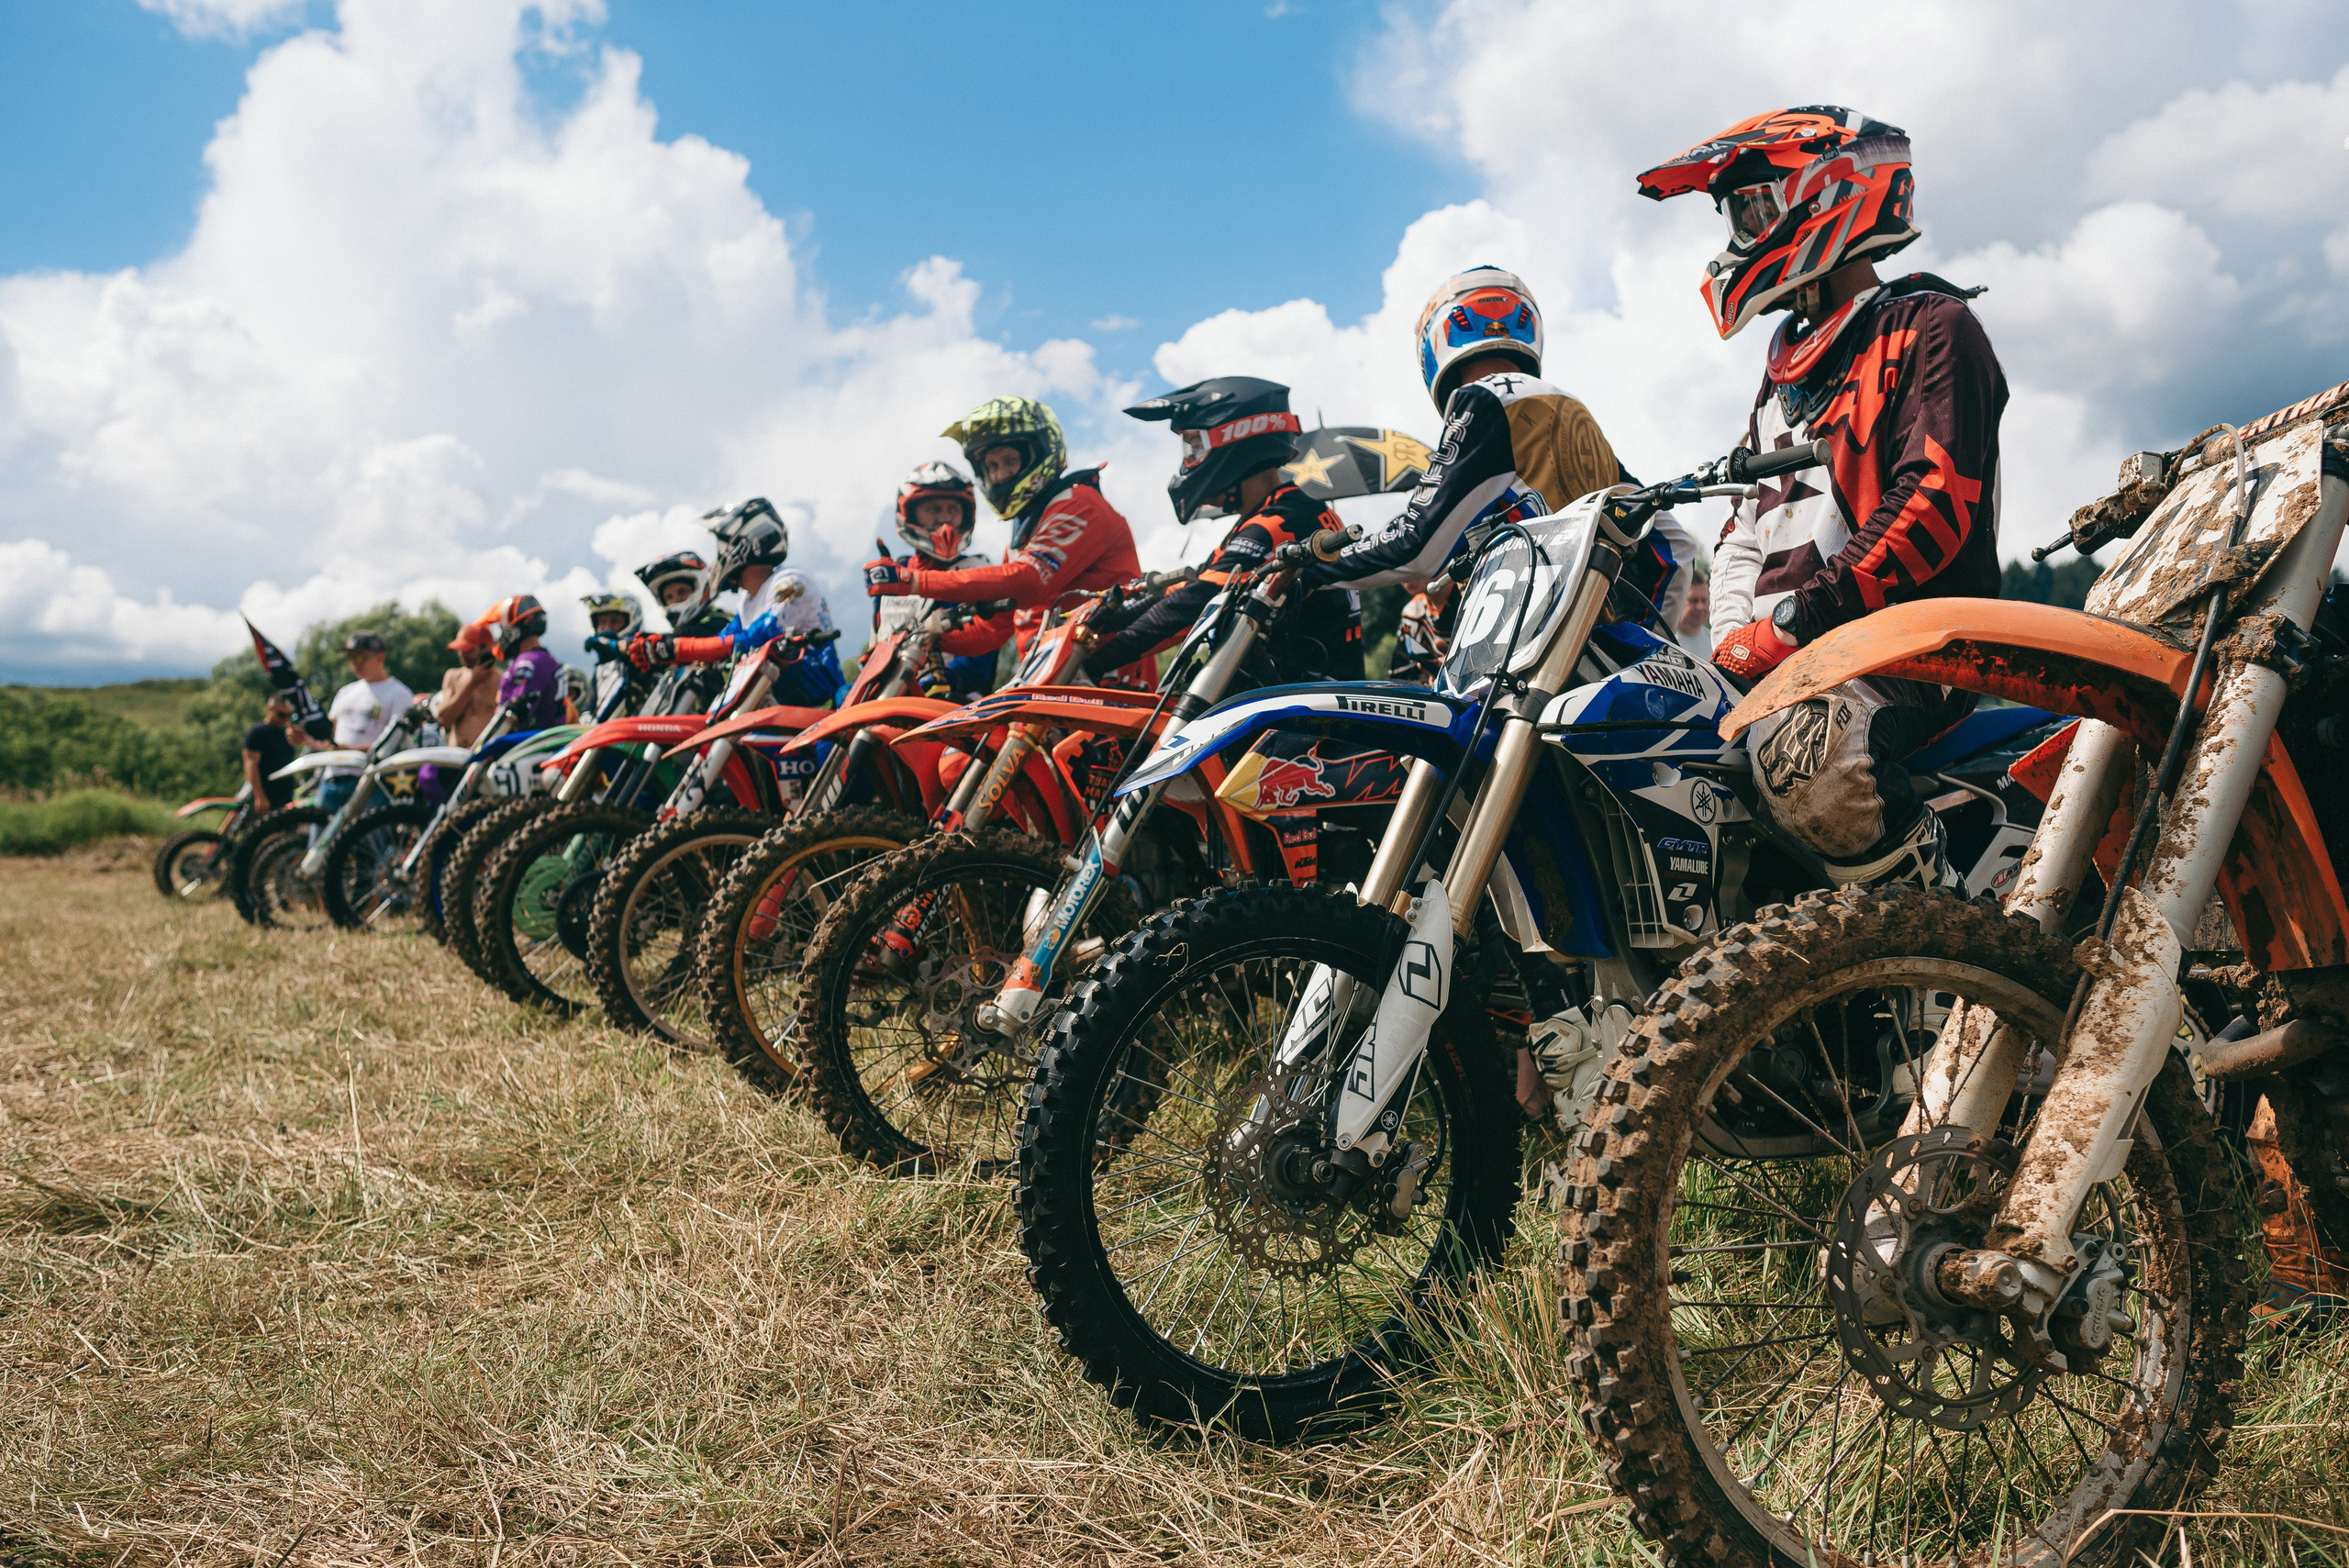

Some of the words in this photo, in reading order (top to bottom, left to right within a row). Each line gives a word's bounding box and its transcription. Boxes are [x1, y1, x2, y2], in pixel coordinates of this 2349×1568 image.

[1220, 415, 1286, 442] 100%
[1446, 565, 1563, 662] 167
[1634, 664, 1707, 700] YAMAHA
[1031, 693, 1067, 703] Red
[1069, 695, 1104, 706] Bull
[1335, 695, 1427, 721] PIRELLI
[638, 724, 682, 733] HONDA
[1835, 701, 1854, 731] FOX
[1284, 829, 1301, 844] Red
[1657, 837, 1709, 854] GYTR
[1670, 856, 1709, 874] YAMALUBE
[886, 886, 914, 907] EXCEL
[1053, 859, 1100, 929] MOTOREX
[912, 884, 952, 948] DUNLO
